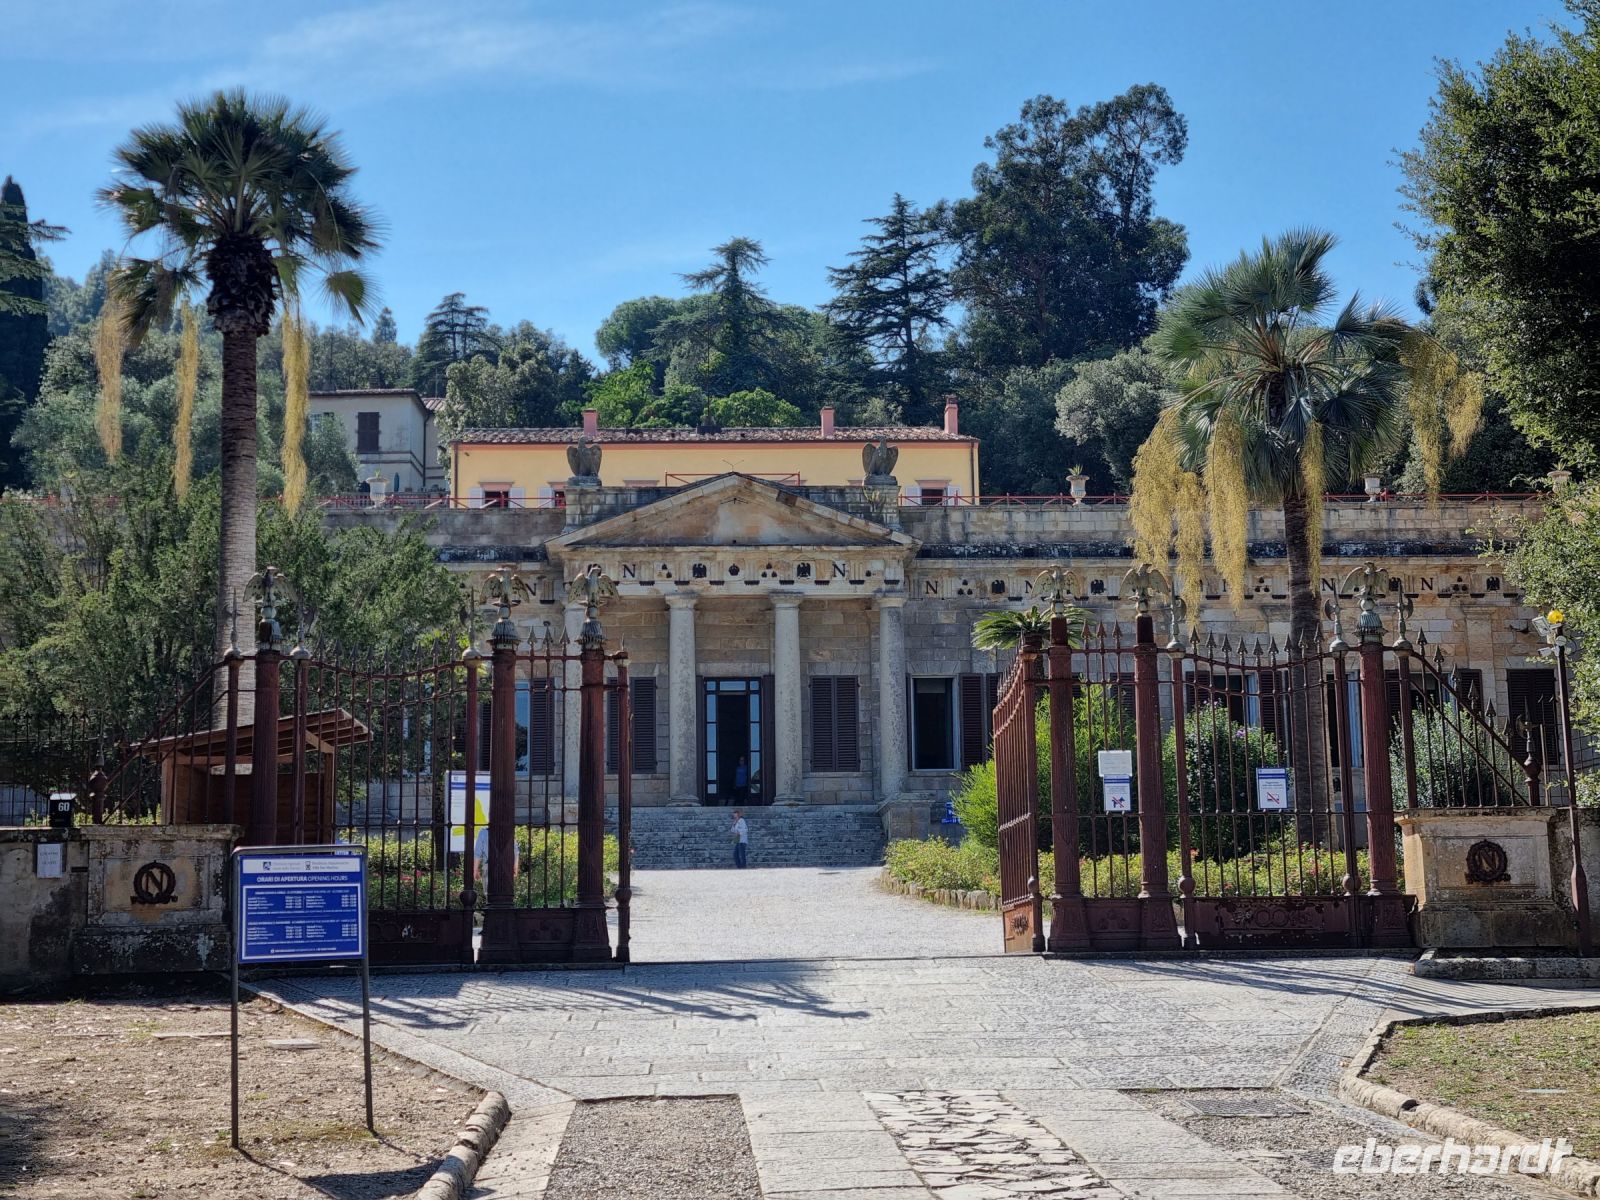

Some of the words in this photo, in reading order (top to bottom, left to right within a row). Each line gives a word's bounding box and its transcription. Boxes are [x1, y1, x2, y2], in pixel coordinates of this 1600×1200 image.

[622, 563, 637, 578] N
[832, 563, 847, 578] N
[925, 580, 939, 594] N
[1420, 577, 1434, 591] N
[58, 802, 70, 812] 60
